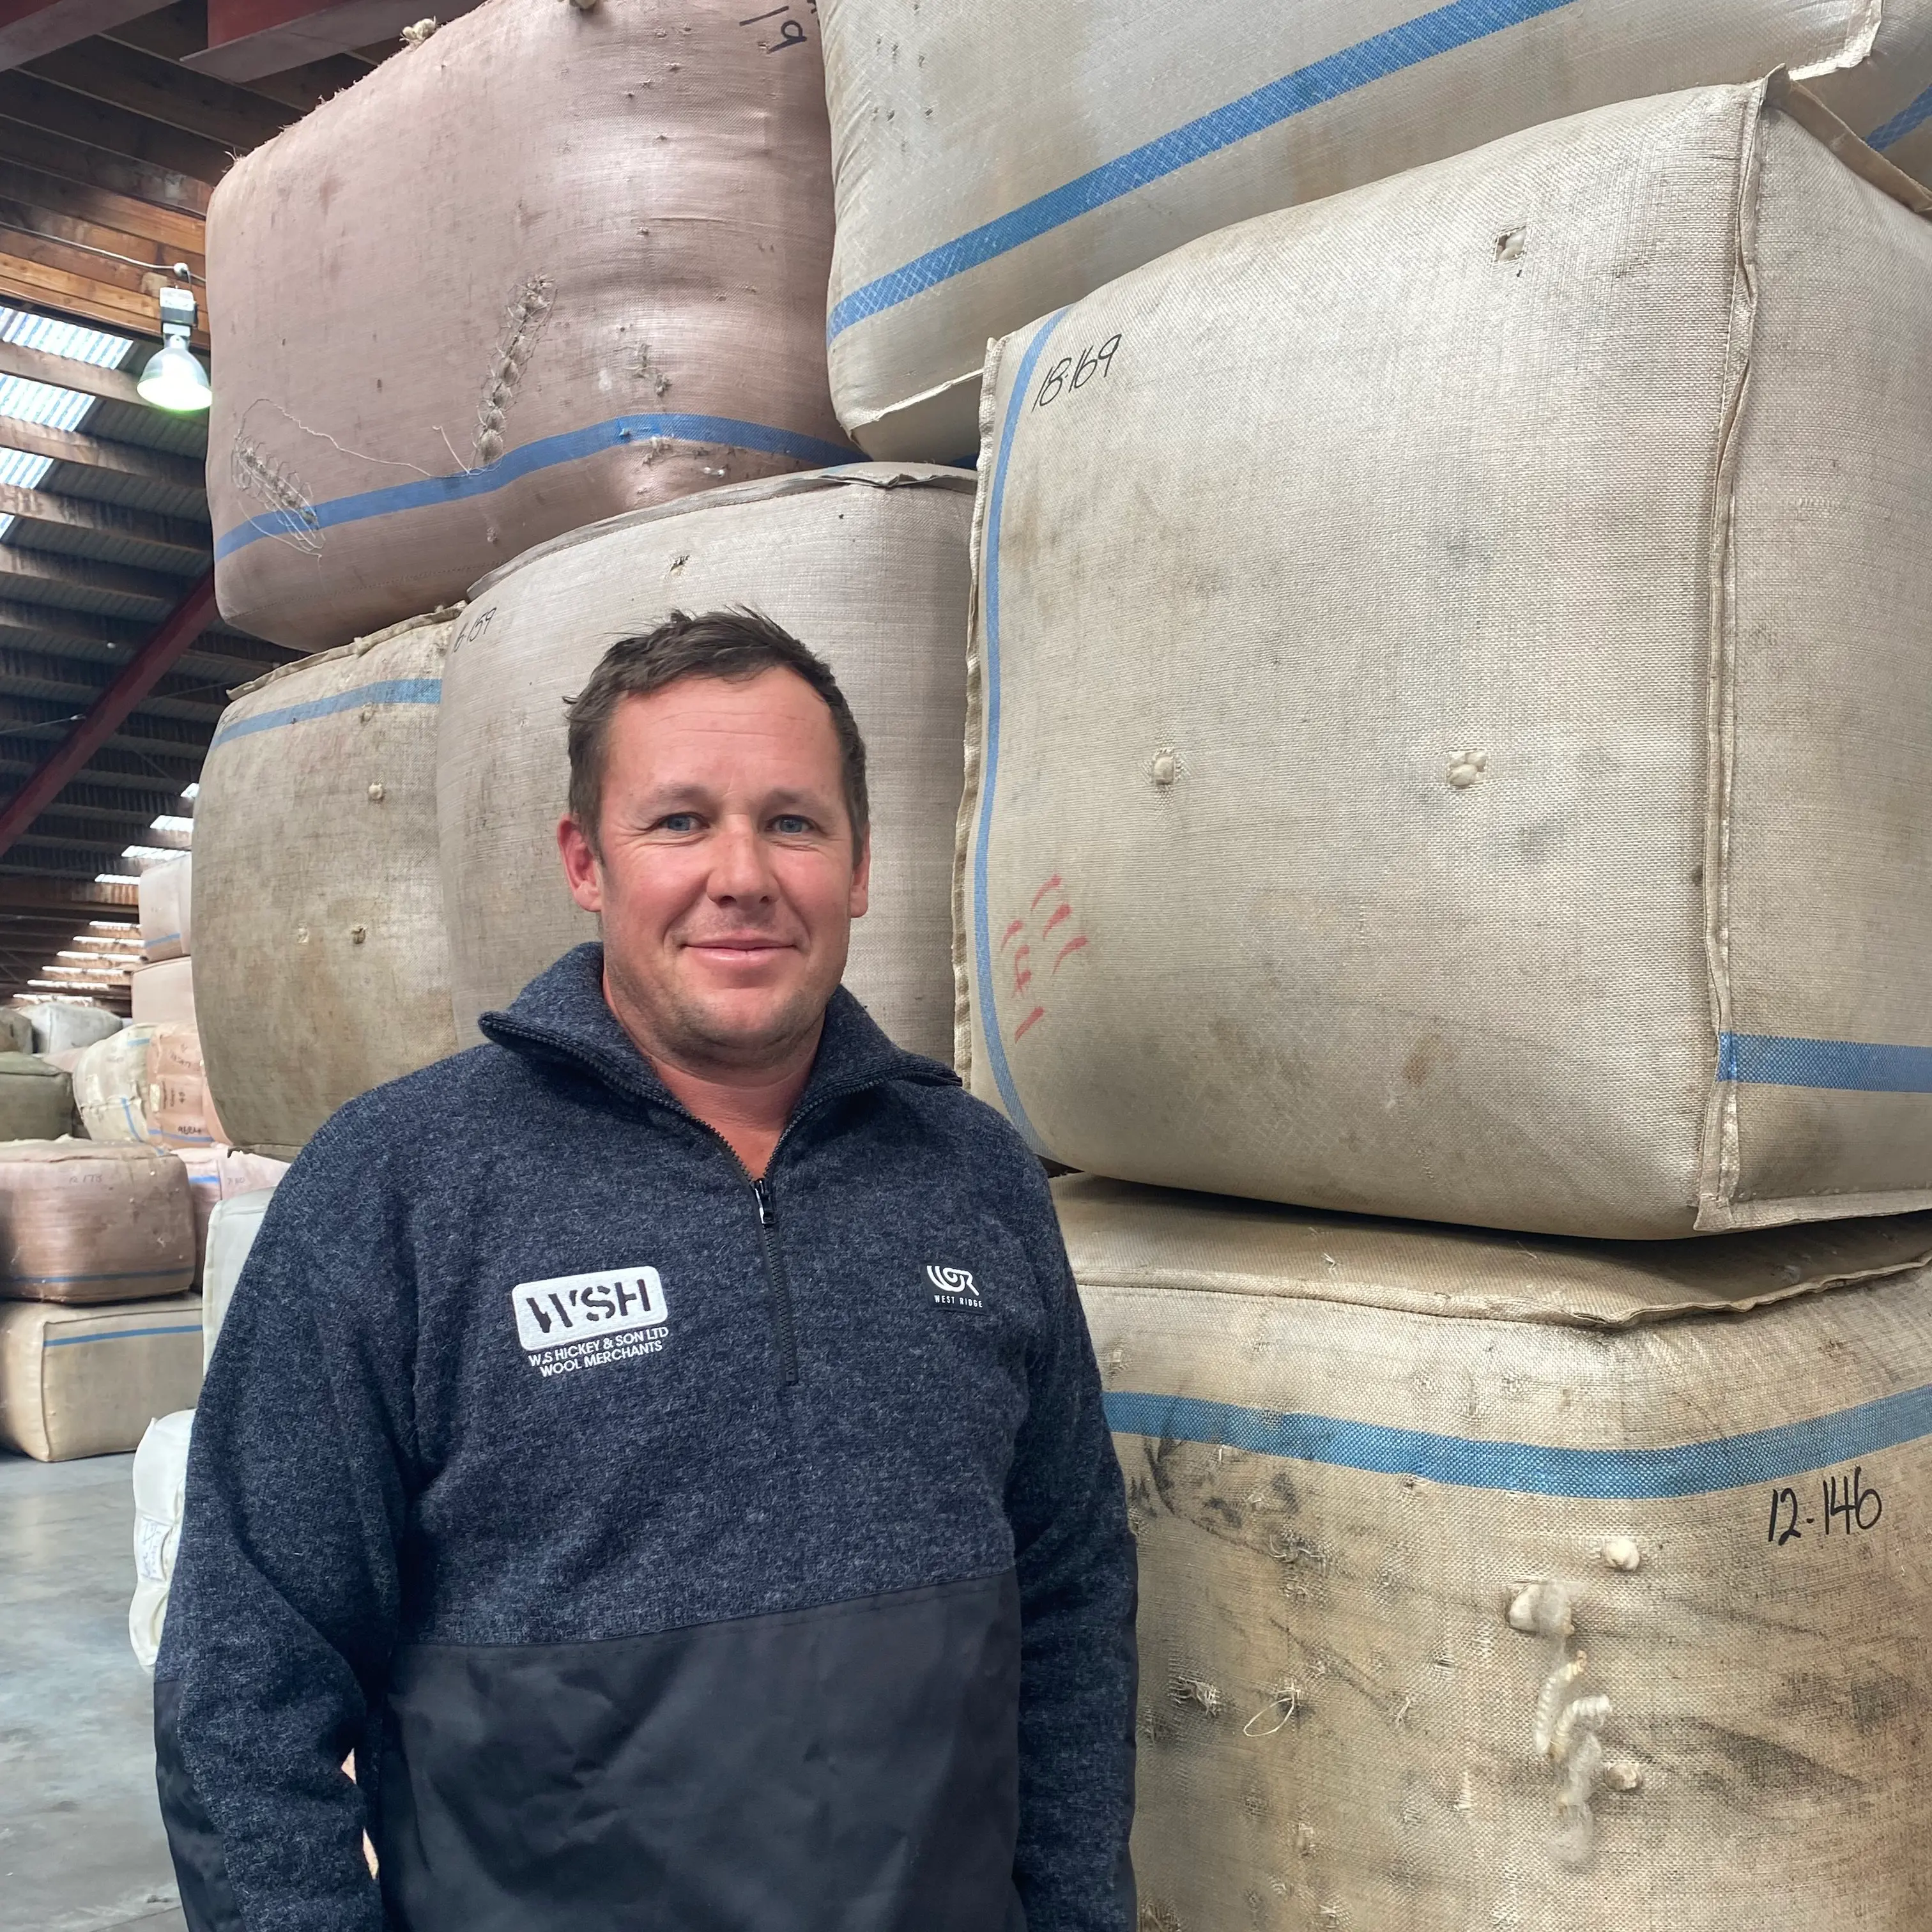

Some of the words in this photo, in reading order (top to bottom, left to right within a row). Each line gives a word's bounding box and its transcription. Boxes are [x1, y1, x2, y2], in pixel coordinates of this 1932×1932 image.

[526, 1278, 651, 1333] WSH
[934, 1295, 955, 1304] WEST
[960, 1298, 983, 1308] RIDGE
[539, 1360, 581, 1377] WOOL
[584, 1340, 663, 1368] MERCHANTS
[555, 1340, 601, 1361] HICKEY
[603, 1337, 613, 1349] &
[615, 1331, 644, 1347] SON
[646, 1326, 669, 1340] LTD
